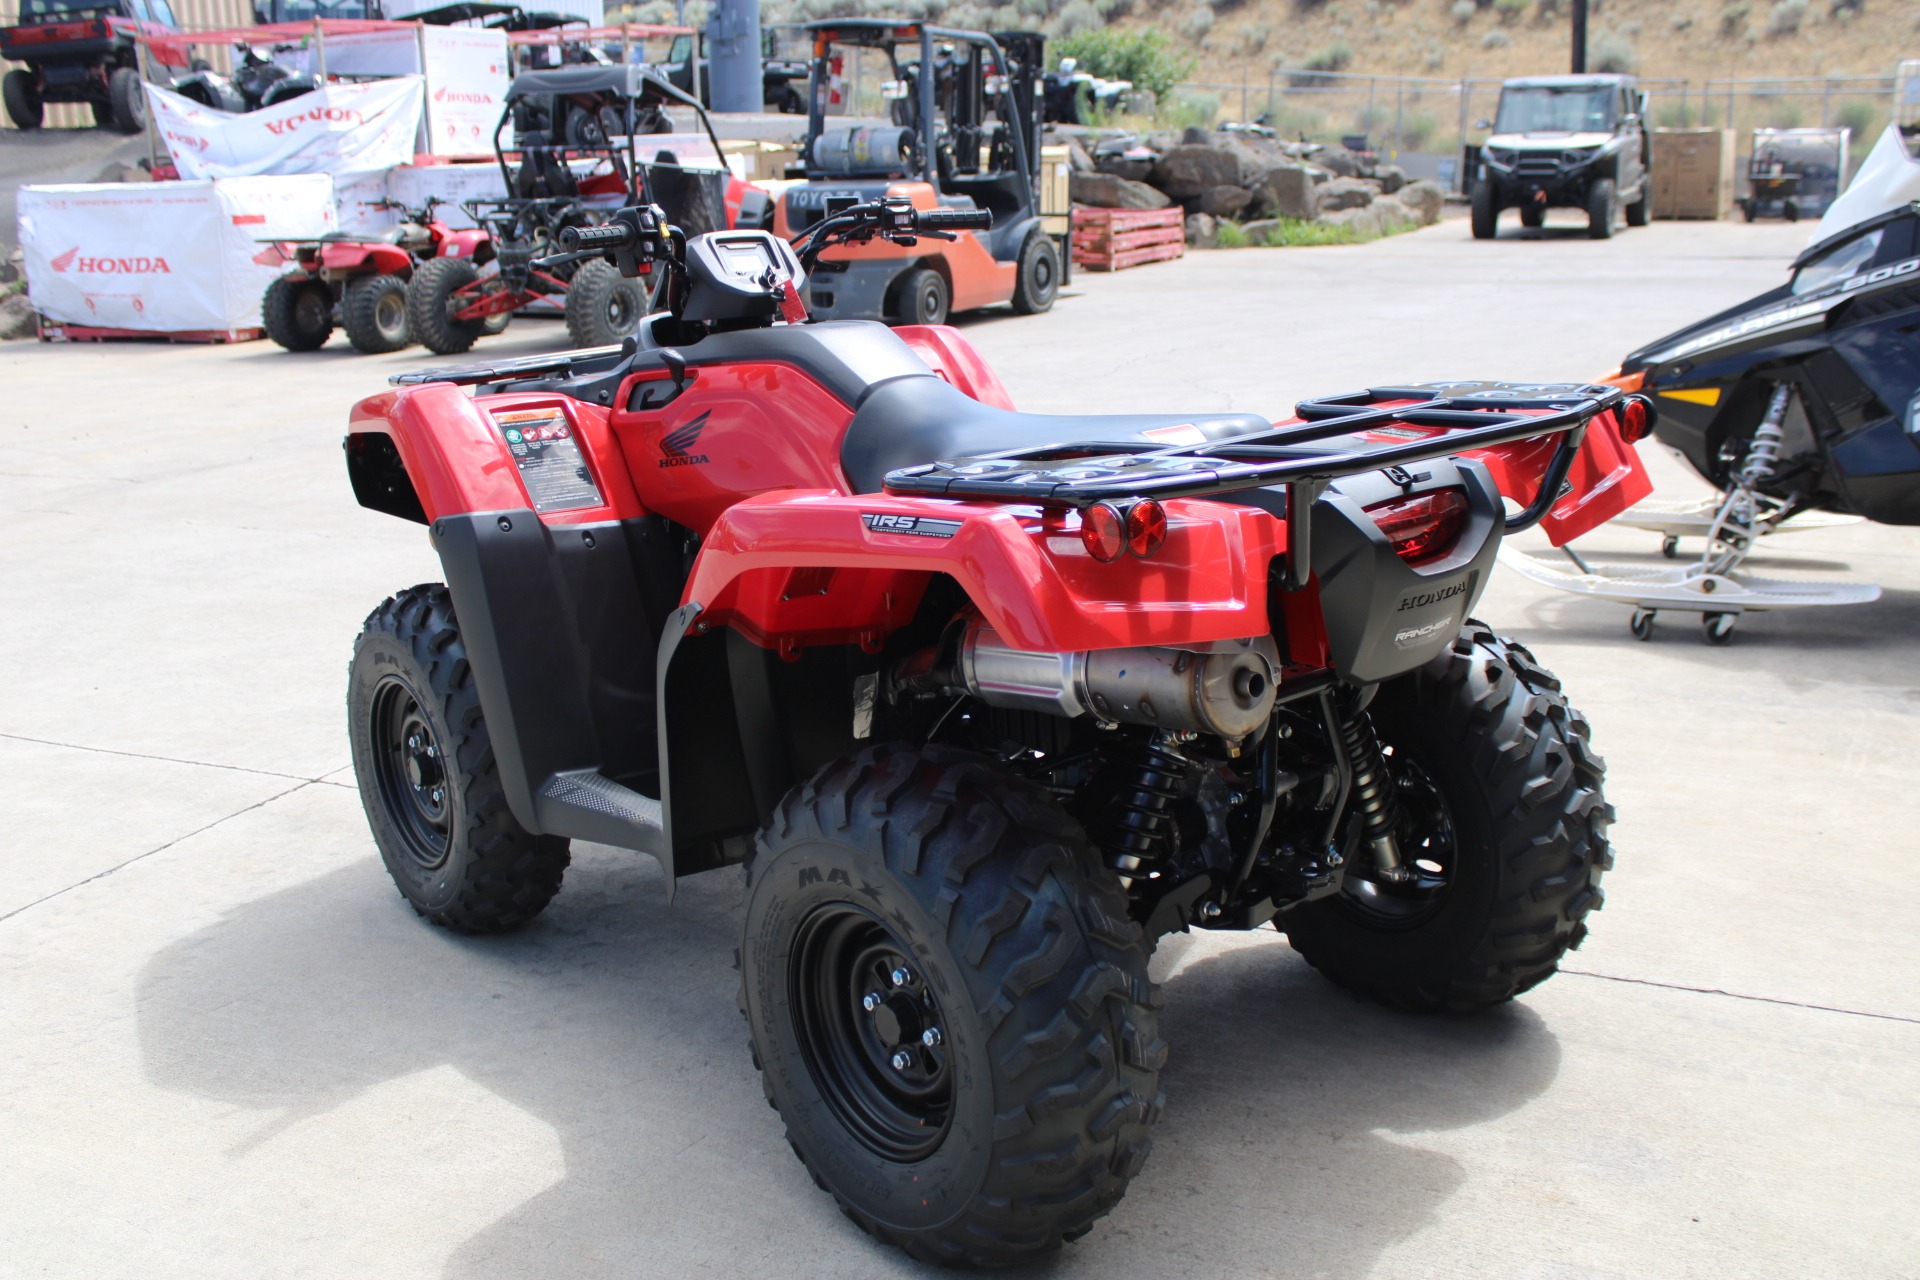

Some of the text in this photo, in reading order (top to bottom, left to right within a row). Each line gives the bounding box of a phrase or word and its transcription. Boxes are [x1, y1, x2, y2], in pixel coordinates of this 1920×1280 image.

[447, 92, 493, 104] HONDA
[77, 257, 172, 274] HONDA
[1841, 258, 1920, 292] 800
[1674, 303, 1823, 357] POLARIS
[659, 454, 710, 468] HONDA
[871, 514, 916, 529] IRS
[1397, 581, 1467, 612] HONDA
[1394, 616, 1452, 642] RANCHER
